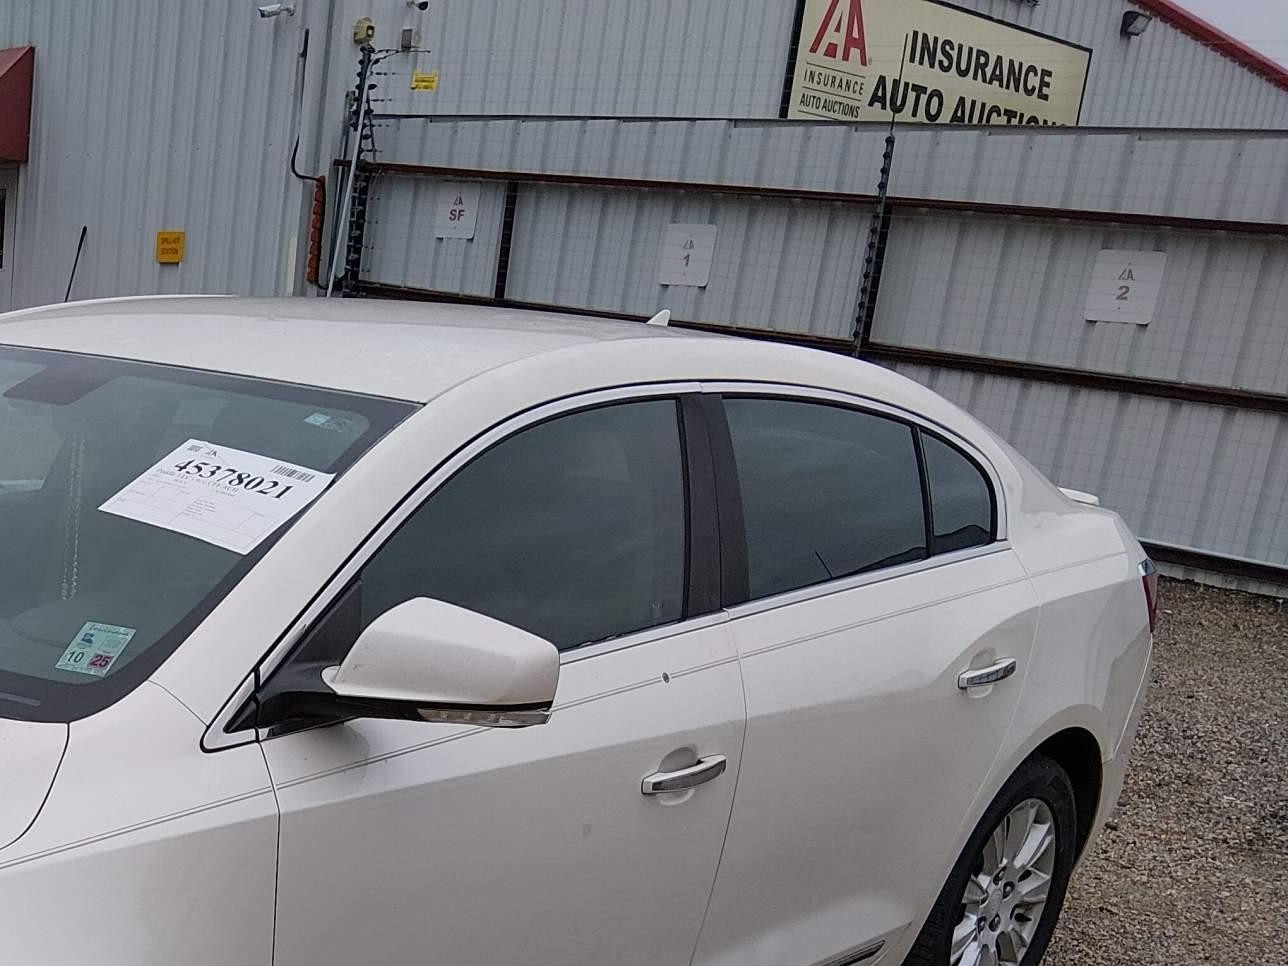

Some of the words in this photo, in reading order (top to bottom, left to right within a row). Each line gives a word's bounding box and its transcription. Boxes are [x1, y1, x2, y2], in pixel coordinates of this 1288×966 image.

[909, 30, 1053, 101] INSURANCE
[804, 68, 865, 96] INSURANCE
[799, 93, 822, 111] AUTO
[821, 98, 860, 119] AUCTIONS
[868, 74, 944, 122] AUTO
[449, 209, 465, 222] SF
[683, 253, 691, 267] 1
[1116, 285, 1130, 300] 2
[173, 458, 294, 500] 45378021
[67, 651, 85, 663] 10
[90, 654, 112, 668] 25
